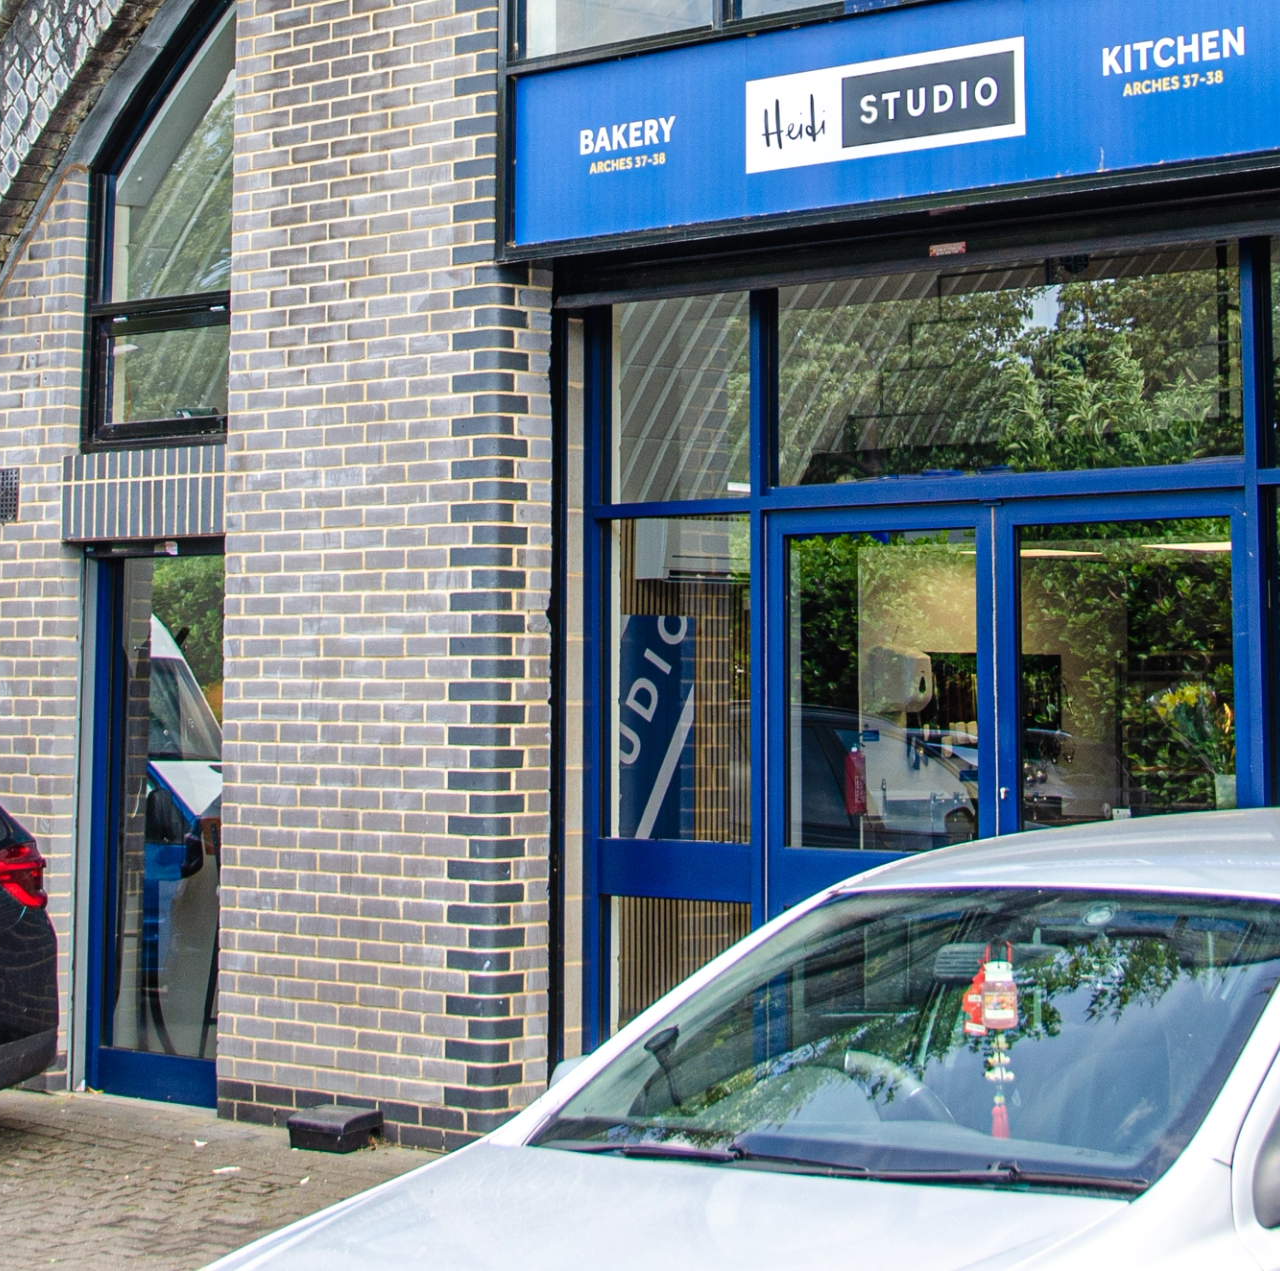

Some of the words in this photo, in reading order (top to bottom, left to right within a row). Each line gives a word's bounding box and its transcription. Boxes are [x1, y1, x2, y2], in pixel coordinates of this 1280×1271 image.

[1102, 26, 1245, 76] KITCHEN
[1123, 75, 1180, 97] ARCHES
[1183, 69, 1223, 88] 37-38
[580, 115, 676, 155] BAKERY
[762, 94, 825, 149] Heidi
[860, 77, 998, 124] STUDIO
[589, 156, 633, 175] ARCHES
[635, 152, 666, 168] 37-38
[620, 615, 688, 764] UDIO
